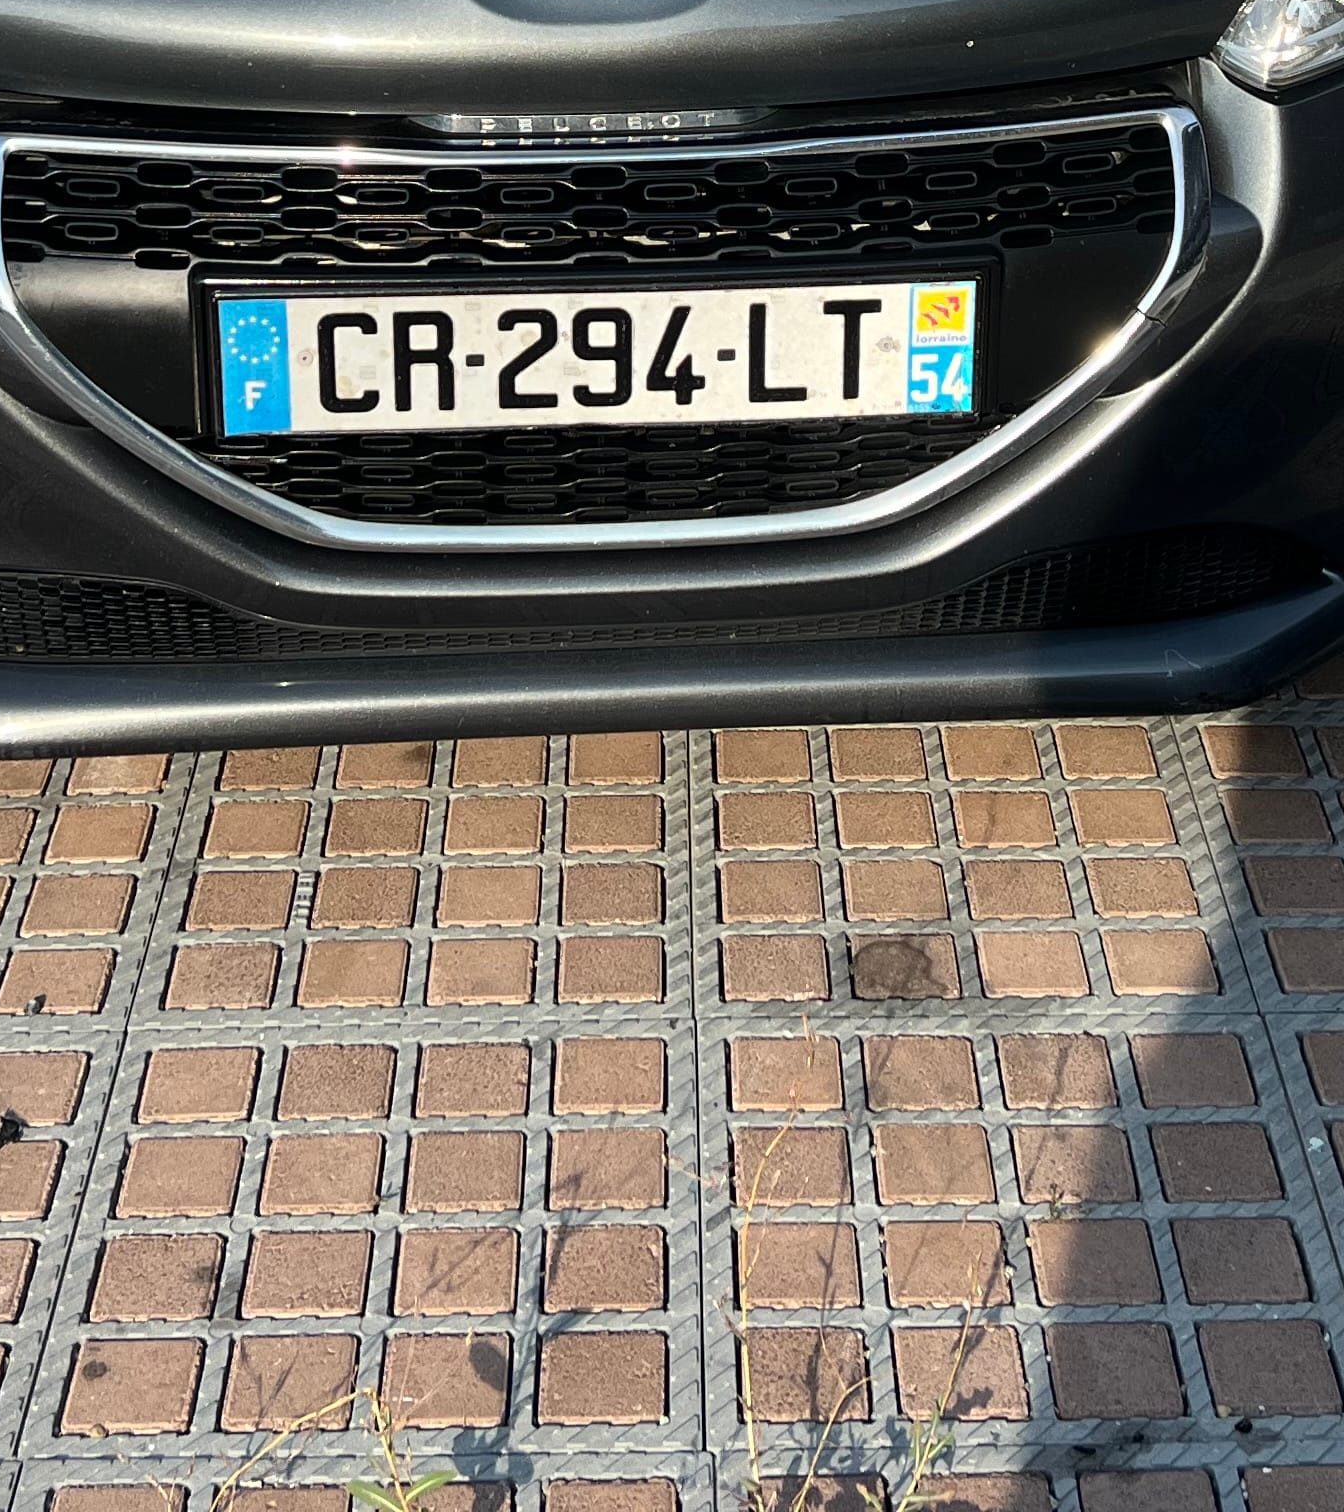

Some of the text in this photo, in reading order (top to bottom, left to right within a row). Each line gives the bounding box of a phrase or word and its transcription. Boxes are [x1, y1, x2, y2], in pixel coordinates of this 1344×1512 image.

[315, 297, 882, 414] CR-294-LT
[916, 333, 968, 344] lorraine
[244, 379, 267, 411] F
[910, 351, 968, 404] 54
